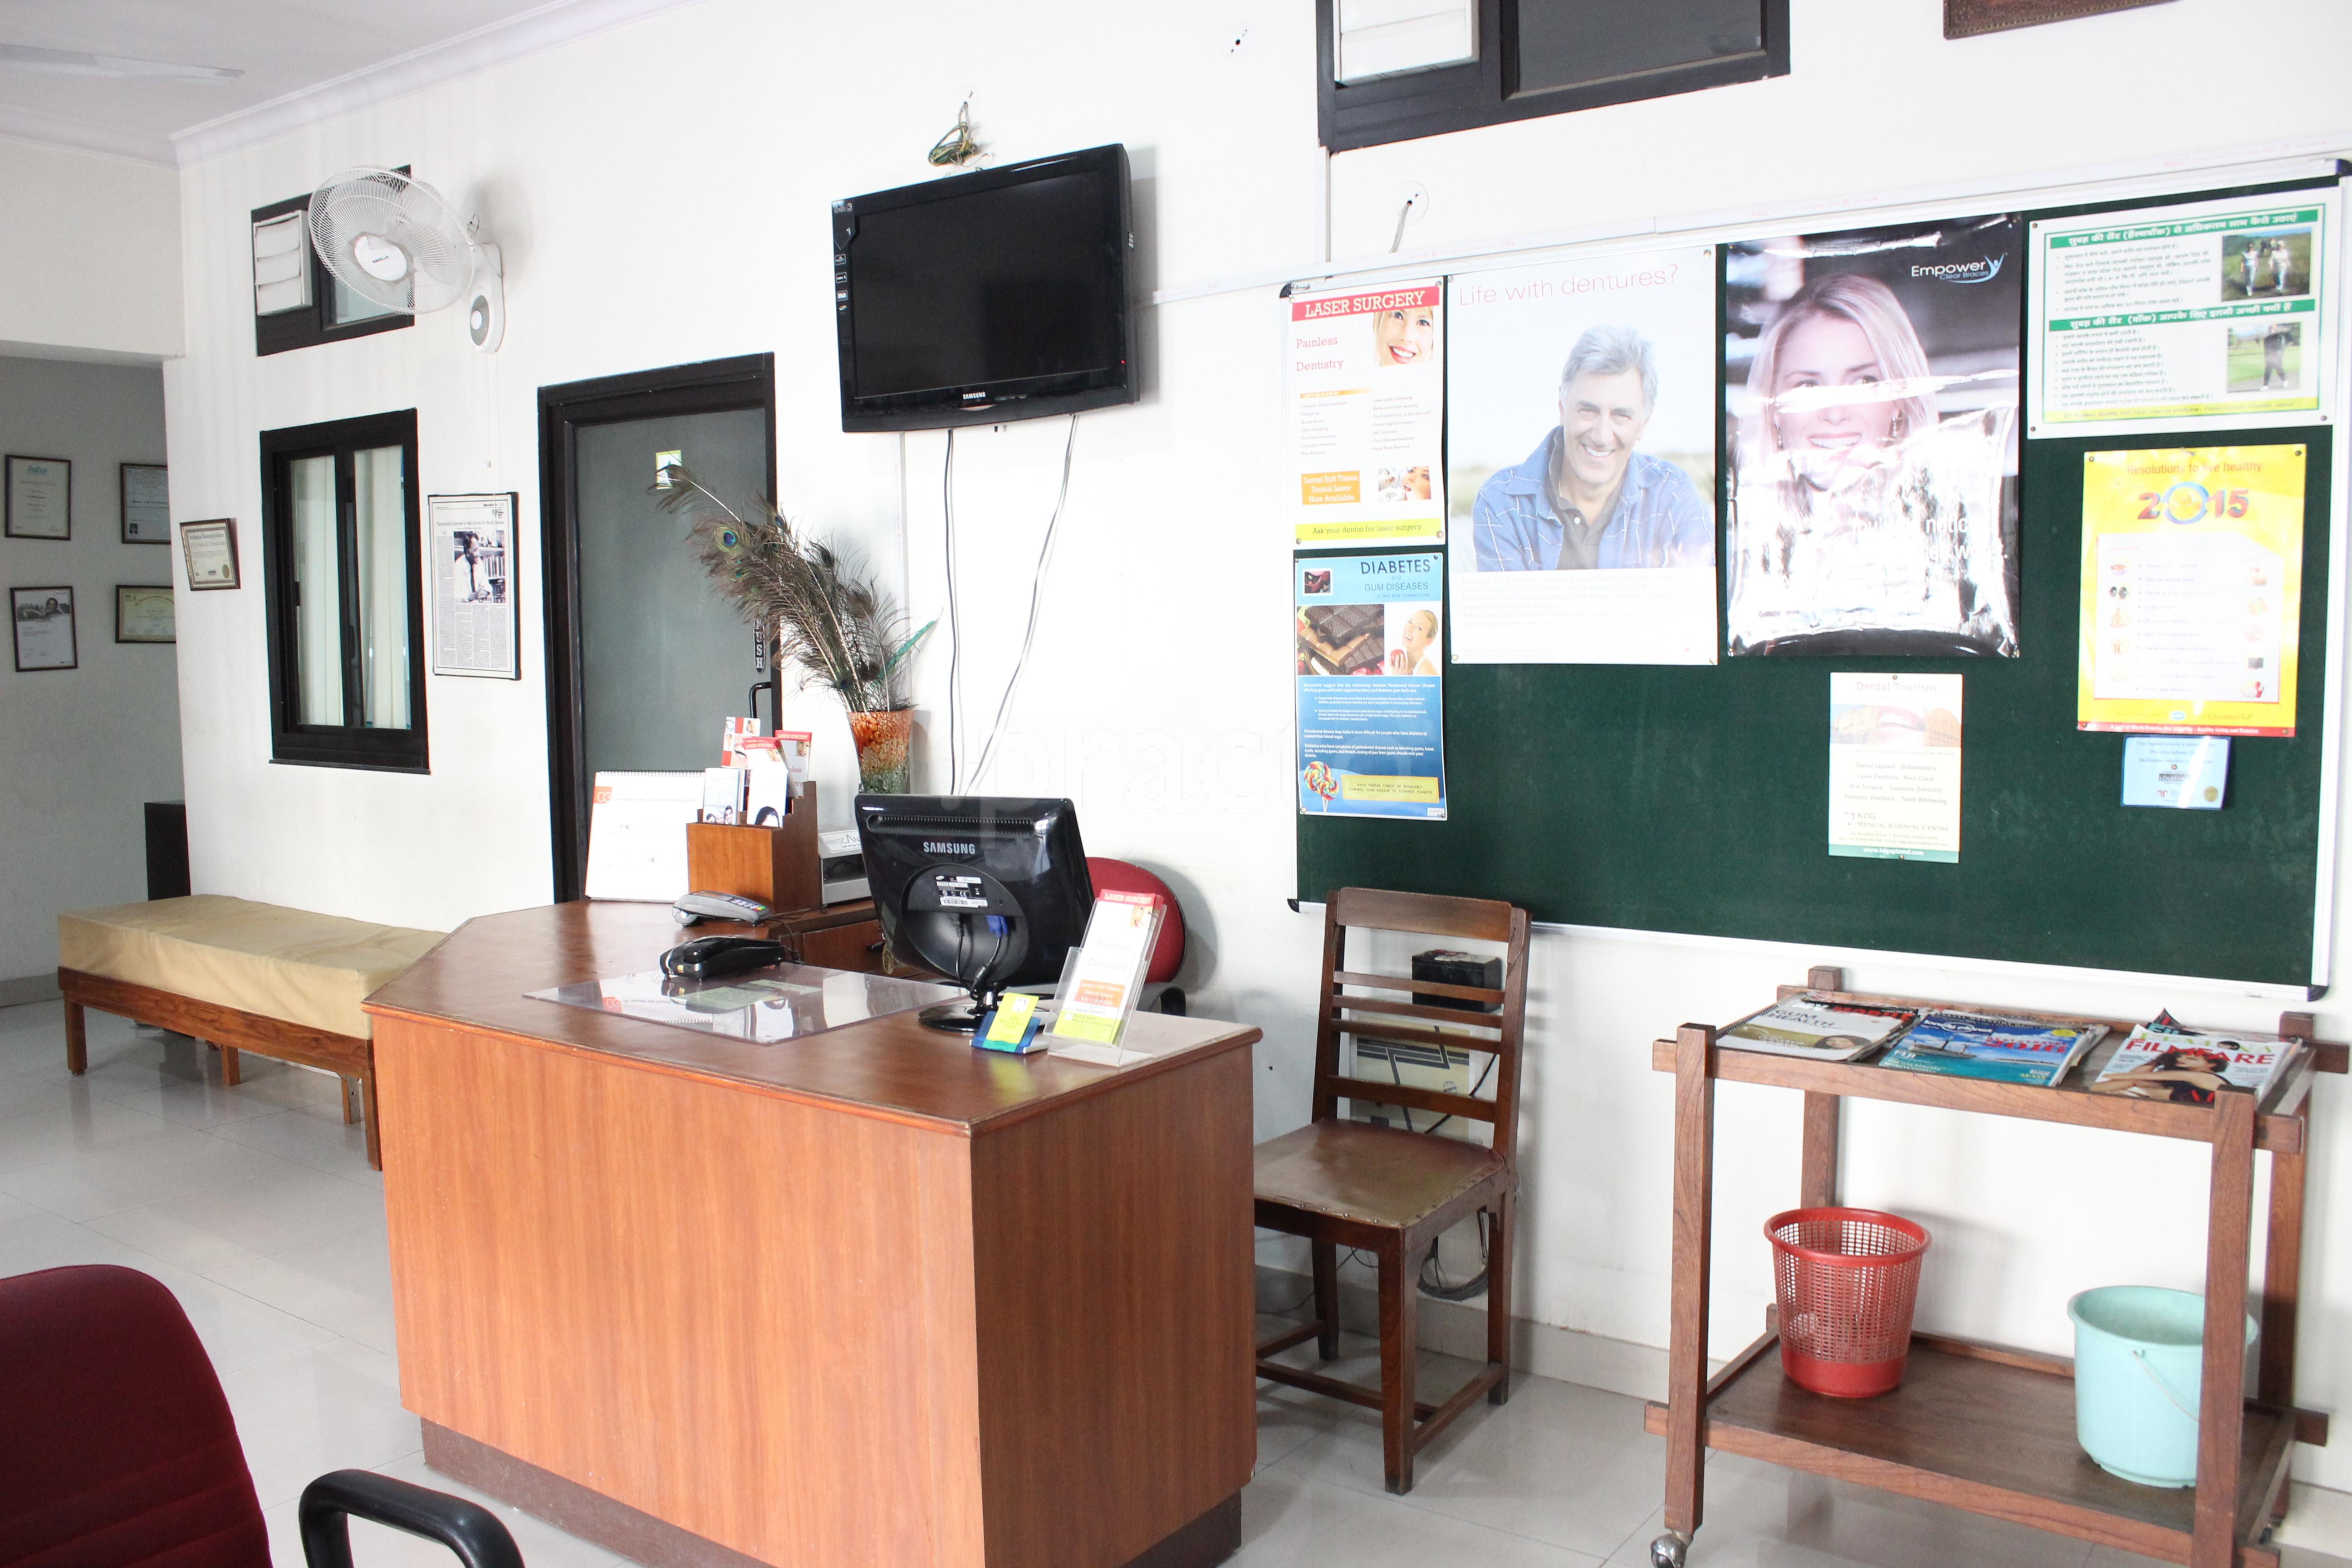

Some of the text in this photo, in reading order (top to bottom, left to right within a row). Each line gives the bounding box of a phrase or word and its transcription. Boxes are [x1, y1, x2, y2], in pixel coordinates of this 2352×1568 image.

[2068, 235, 2089, 247] सुबह
[2091, 233, 2104, 243] की
[2106, 231, 2121, 242] सैर
[2185, 222, 2226, 234] अधिकतम
[1911, 261, 1986, 277] Empower
[1460, 263, 1679, 306] Life with dentures?
[1305, 291, 1424, 318] LASER SURGERY
[2070, 319, 2090, 330] सुबह
[2092, 317, 2106, 326] की
[2108, 315, 2122, 326] सैर
[2159, 311, 2187, 321] आपके
[2189, 309, 2207, 321] लिए
[1296, 336, 1338, 348] Painless
[1296, 360, 1343, 372] Dentistry
[962, 392, 986, 400] SAMSUNG
[2127, 464, 2185, 475] Resolutions
[2189, 464, 2198, 472] to
[2223, 462, 2262, 473] healthy
[1324, 494, 1354, 502] Available
[2137, 481, 2249, 524] 2015
[1361, 559, 1431, 574] DIABETES
[1365, 582, 1428, 591] GUM DISEASES
[1856, 681, 1937, 691] Dental Tourism
[597, 791, 612, 802] 03
[1918, 797, 1947, 805] Whitening
[923, 842, 975, 855] SAMSUNG
[1104, 893, 1152, 904] LASER SURGERY
[1097, 938, 1133, 951] Painless
[1088, 957, 1128, 971] Dentistry
[1769, 1013, 1836, 1028] HEALTH
[1775, 1009, 1818, 1019] GUM
[2124, 1039, 2276, 1065] FILMFARE
